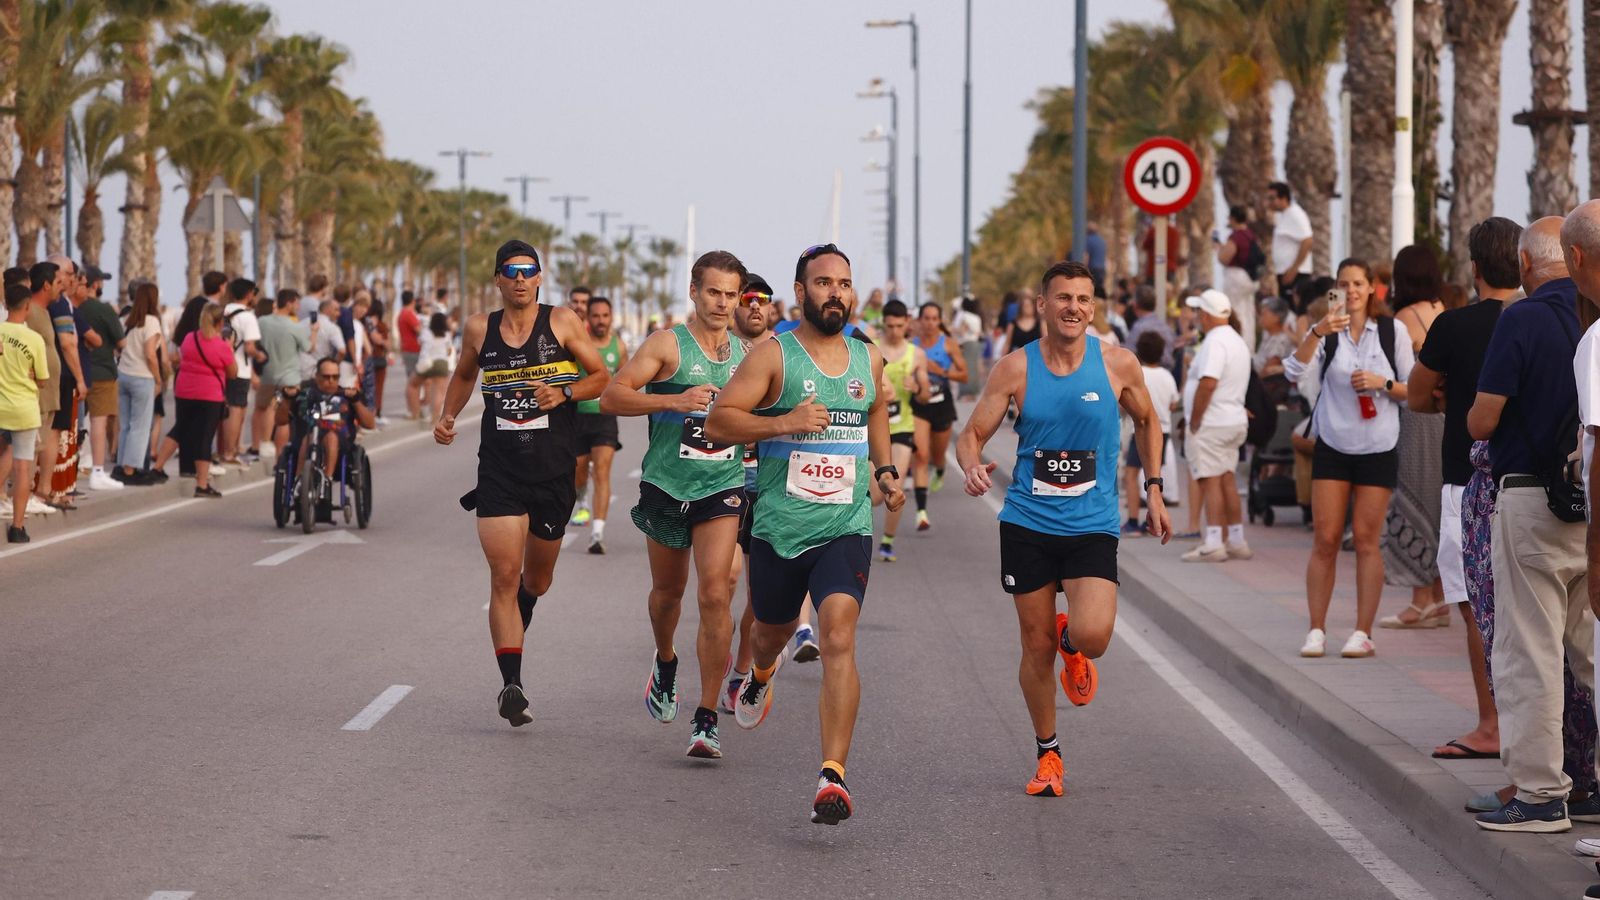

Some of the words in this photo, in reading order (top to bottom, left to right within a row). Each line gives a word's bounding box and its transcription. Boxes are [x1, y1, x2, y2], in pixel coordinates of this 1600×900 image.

[1140, 161, 1180, 189] 40
[485, 374, 498, 383] LUB
[501, 398, 539, 410] 2245
[827, 411, 862, 425] TISMO
[800, 463, 845, 479] 4169
[1047, 459, 1082, 472] 903
